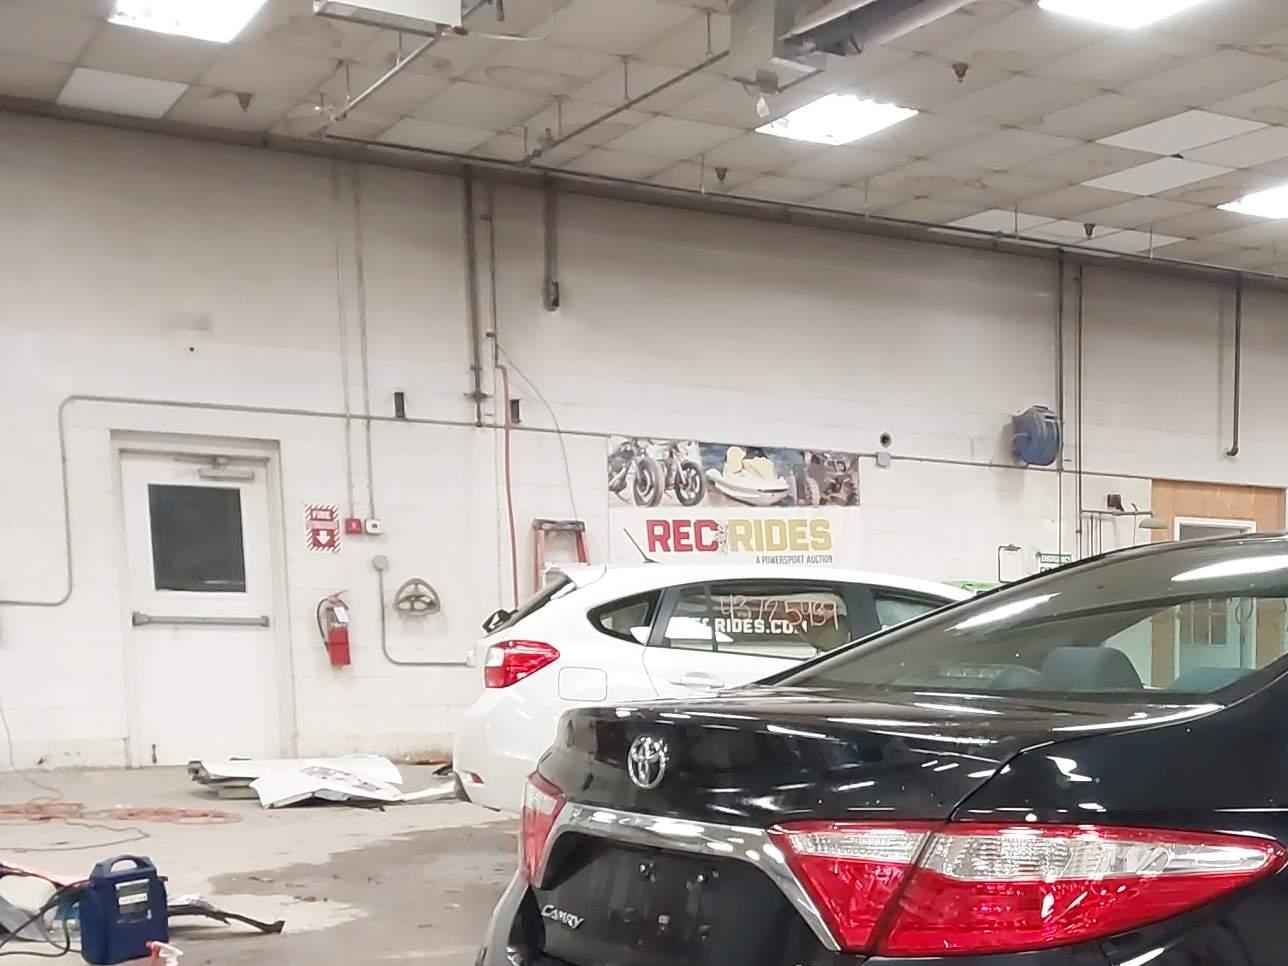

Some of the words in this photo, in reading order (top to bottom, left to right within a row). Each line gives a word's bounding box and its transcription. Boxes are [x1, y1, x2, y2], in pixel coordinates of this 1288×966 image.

[646, 519, 719, 552] REC
[727, 519, 833, 552] RIDES
[762, 554, 804, 565] POWERSPORT
[806, 554, 833, 564] AUCTION
